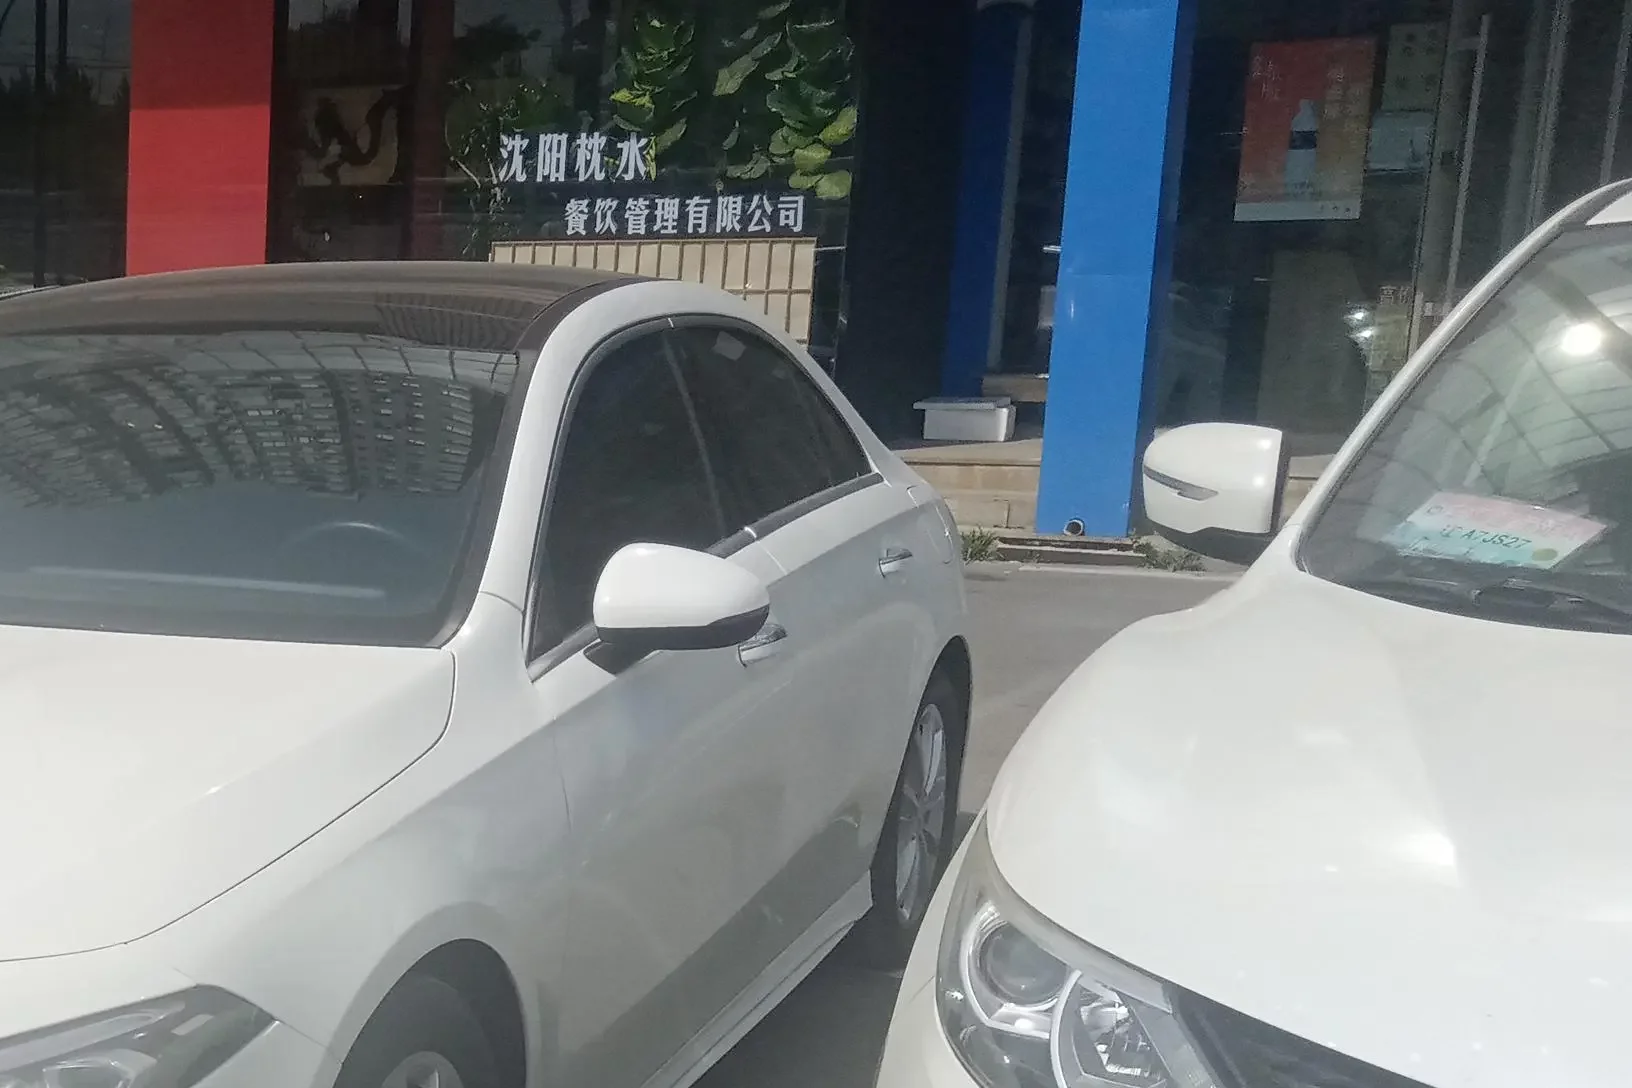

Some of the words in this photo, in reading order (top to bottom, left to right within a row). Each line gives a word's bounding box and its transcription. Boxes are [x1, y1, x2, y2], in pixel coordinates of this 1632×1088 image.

[498, 131, 649, 183] 沈阳枕水
[563, 195, 805, 236] 餐饮管理有限公司
